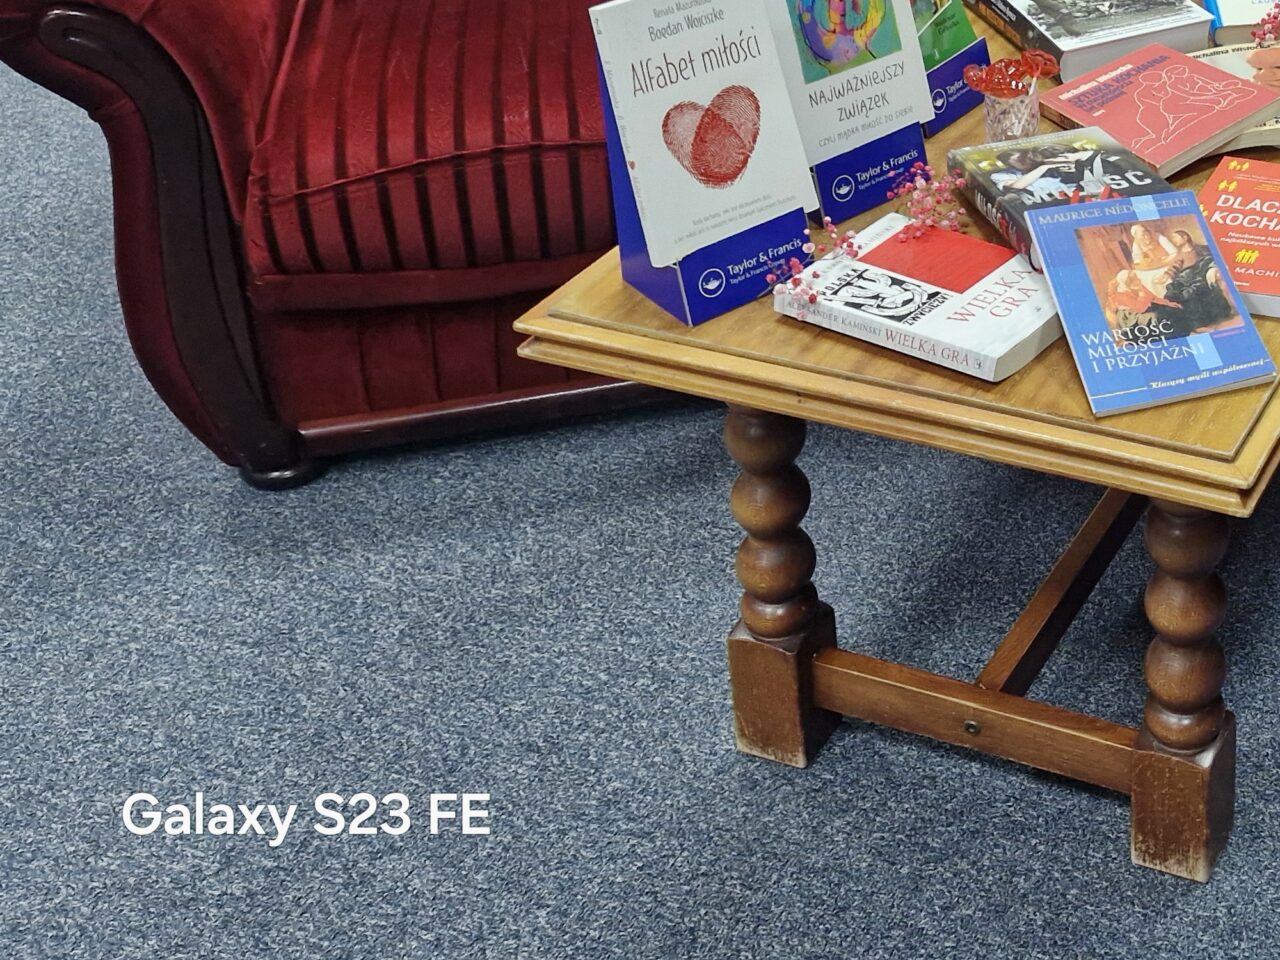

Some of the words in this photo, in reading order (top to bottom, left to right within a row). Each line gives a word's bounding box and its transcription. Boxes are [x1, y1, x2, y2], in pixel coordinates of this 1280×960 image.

[630, 50, 697, 97] Alfabet
[701, 25, 762, 74] miłości
[855, 165, 882, 182] Taylor
[882, 162, 890, 171] &
[889, 148, 919, 169] Francis
[1039, 208, 1103, 225] MAURICE
[727, 257, 757, 276] Taylor
[758, 251, 768, 262] &
[768, 237, 802, 259] Francis
[946, 266, 1033, 324] WIELKA
[989, 286, 1039, 318] GRA
[884, 328, 937, 356] WIELKA
[940, 347, 969, 367] GRA
[1081, 318, 1174, 346] WARTOŚĆ
[1088, 336, 1168, 360] MIŁOŚCI
[1092, 362, 1100, 374] I
[1106, 342, 1205, 372] PRZYJAŹNI
